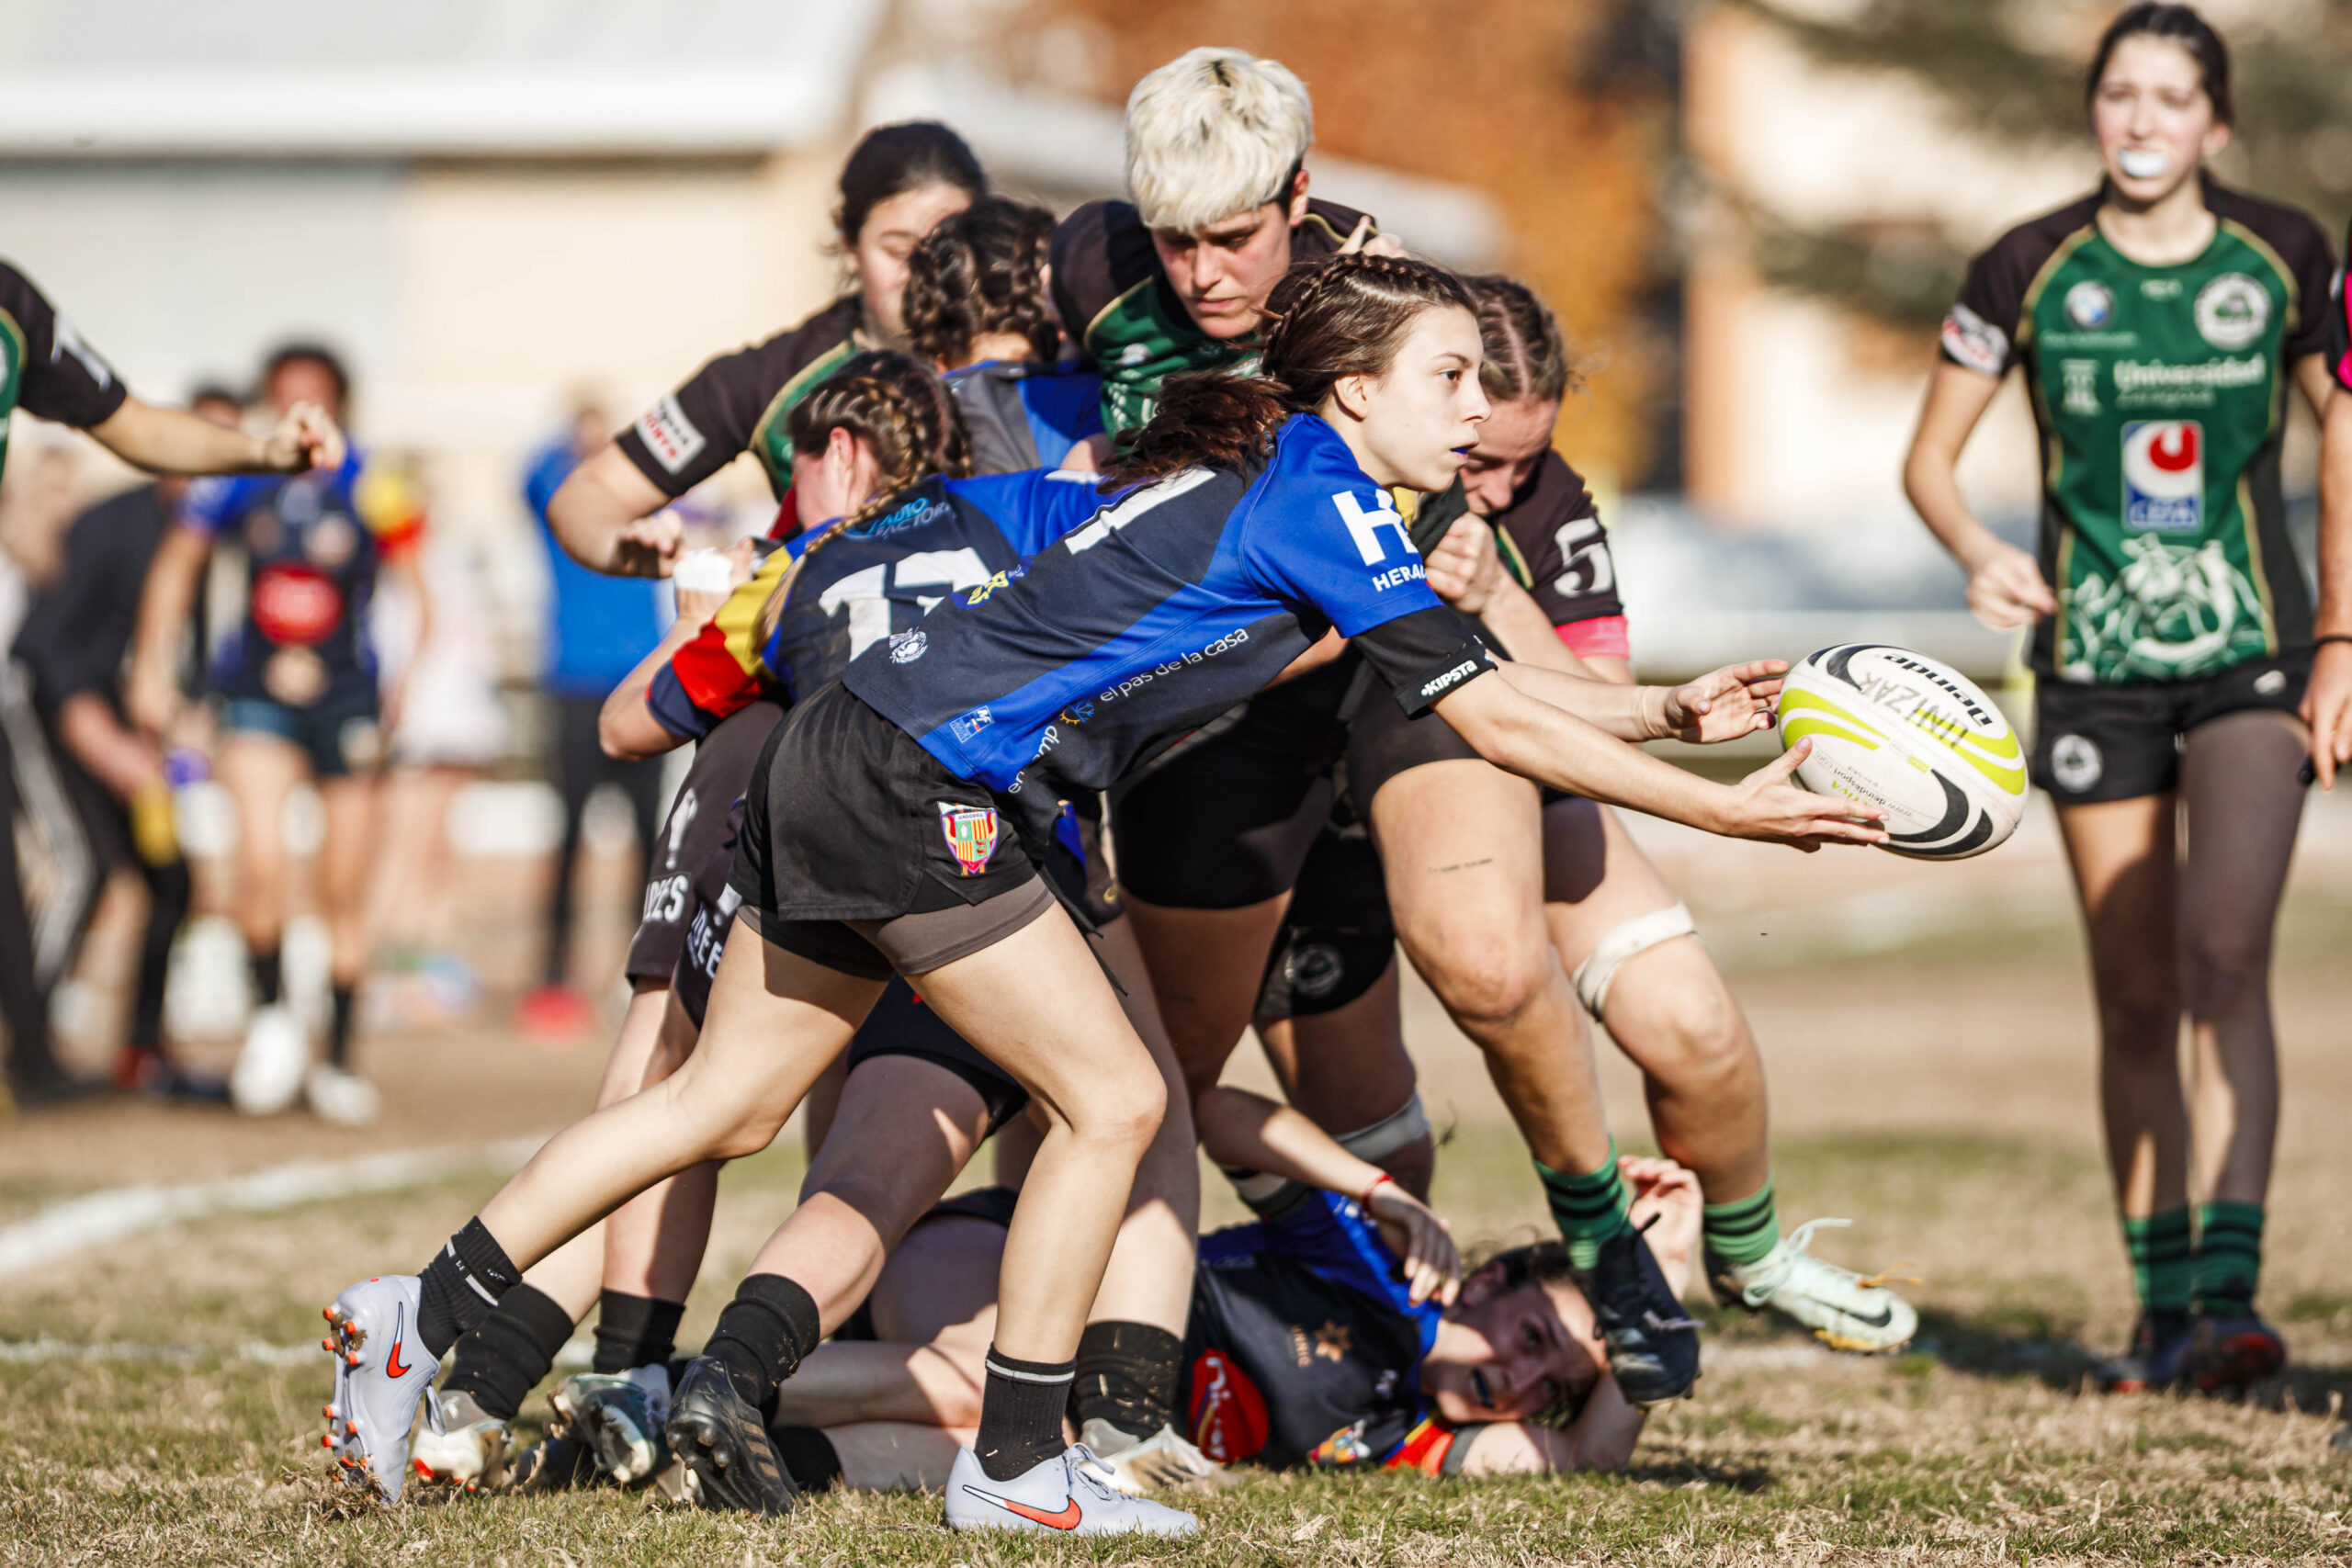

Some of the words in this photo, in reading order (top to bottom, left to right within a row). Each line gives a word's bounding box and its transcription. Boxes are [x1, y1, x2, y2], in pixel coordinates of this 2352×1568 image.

[2114, 352, 2267, 391] Universidad
[1555, 516, 1612, 598] 5
[1100, 686, 1118, 702] el
[1116, 671, 1153, 697] pas
[1155, 660, 1182, 676] de
[1181, 651, 1203, 671] la
[1204, 628, 1249, 657] casa
